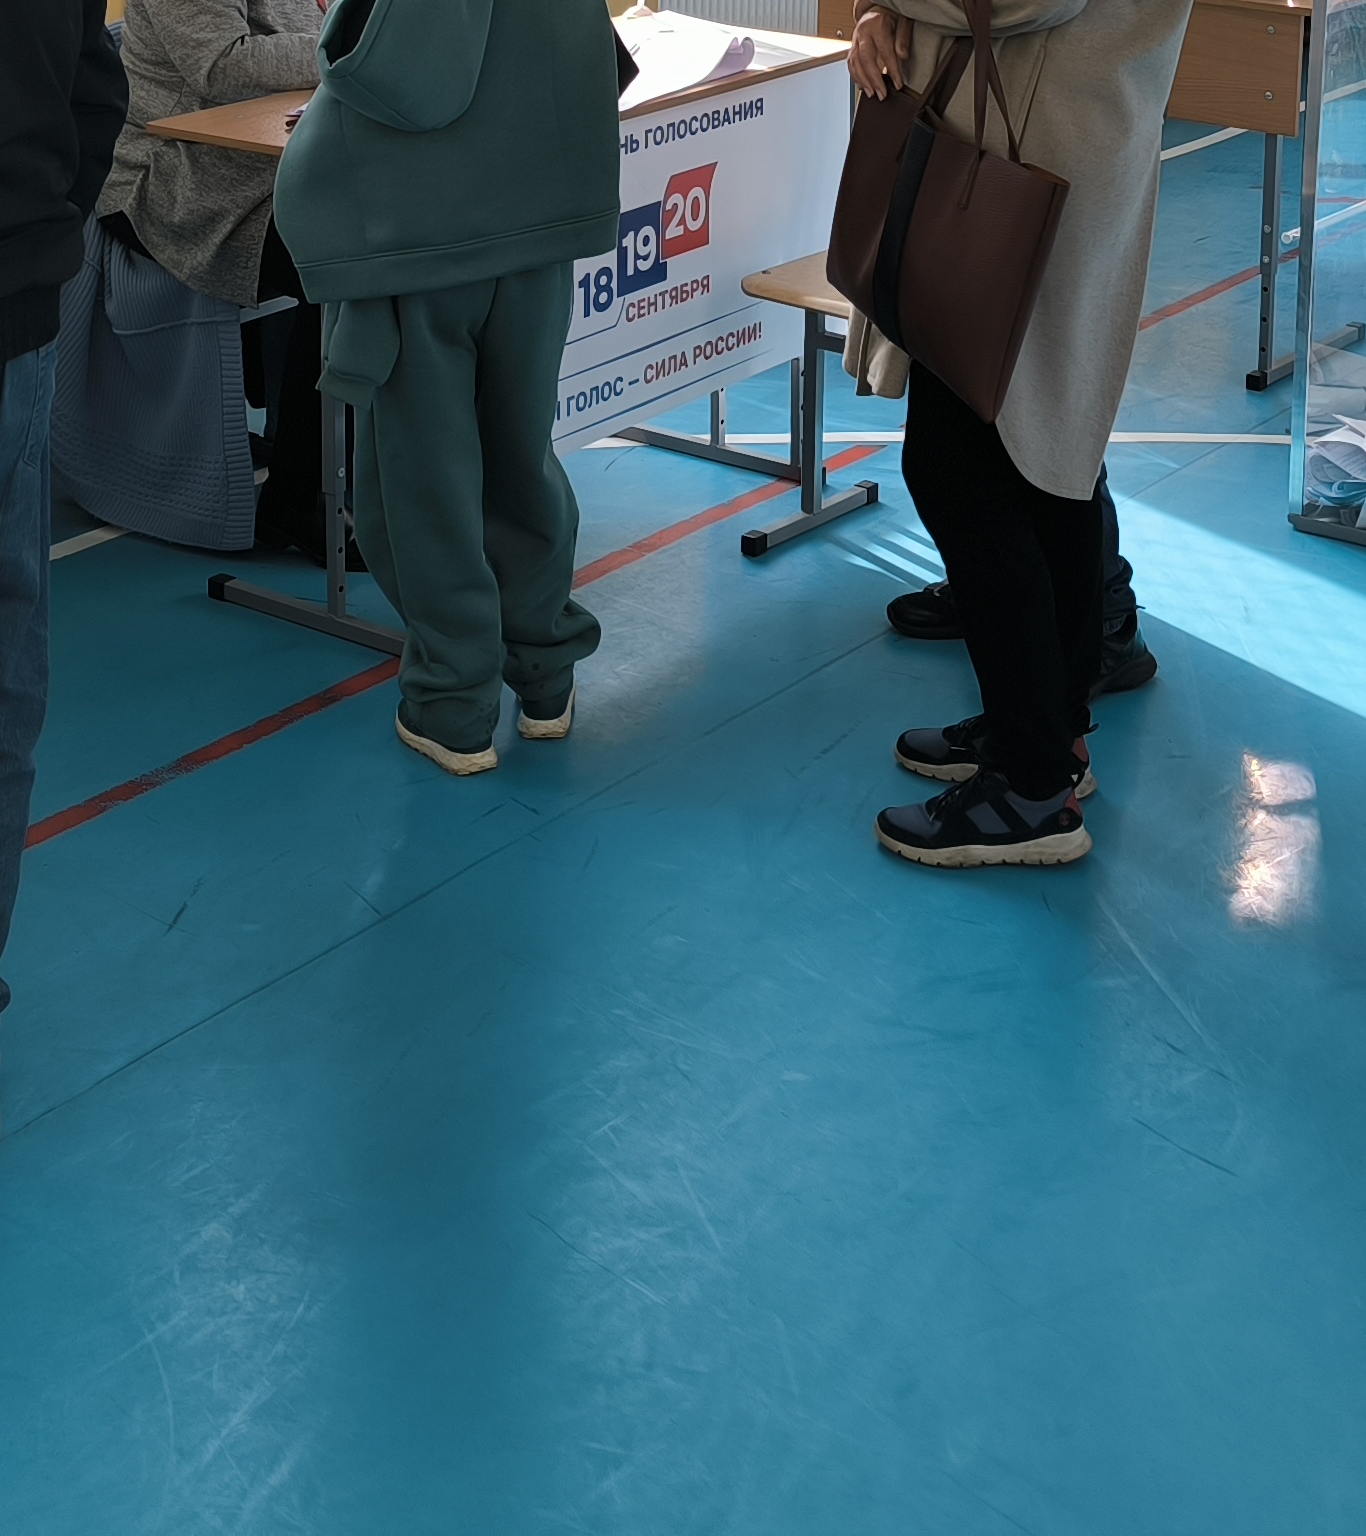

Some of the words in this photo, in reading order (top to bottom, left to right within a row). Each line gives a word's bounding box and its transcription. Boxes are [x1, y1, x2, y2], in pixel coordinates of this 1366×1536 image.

[620, 133, 640, 155] НЬ
[644, 97, 764, 150] ГОЛОСОВАНИЯ
[578, 266, 614, 319] 18
[621, 225, 657, 277] 19
[664, 186, 707, 240] 20
[625, 274, 710, 323] СЕНТЯБРЯ
[566, 376, 624, 417] ГОЛОС
[643, 350, 688, 385] СИЛА
[692, 320, 763, 366] РОССИИ!
